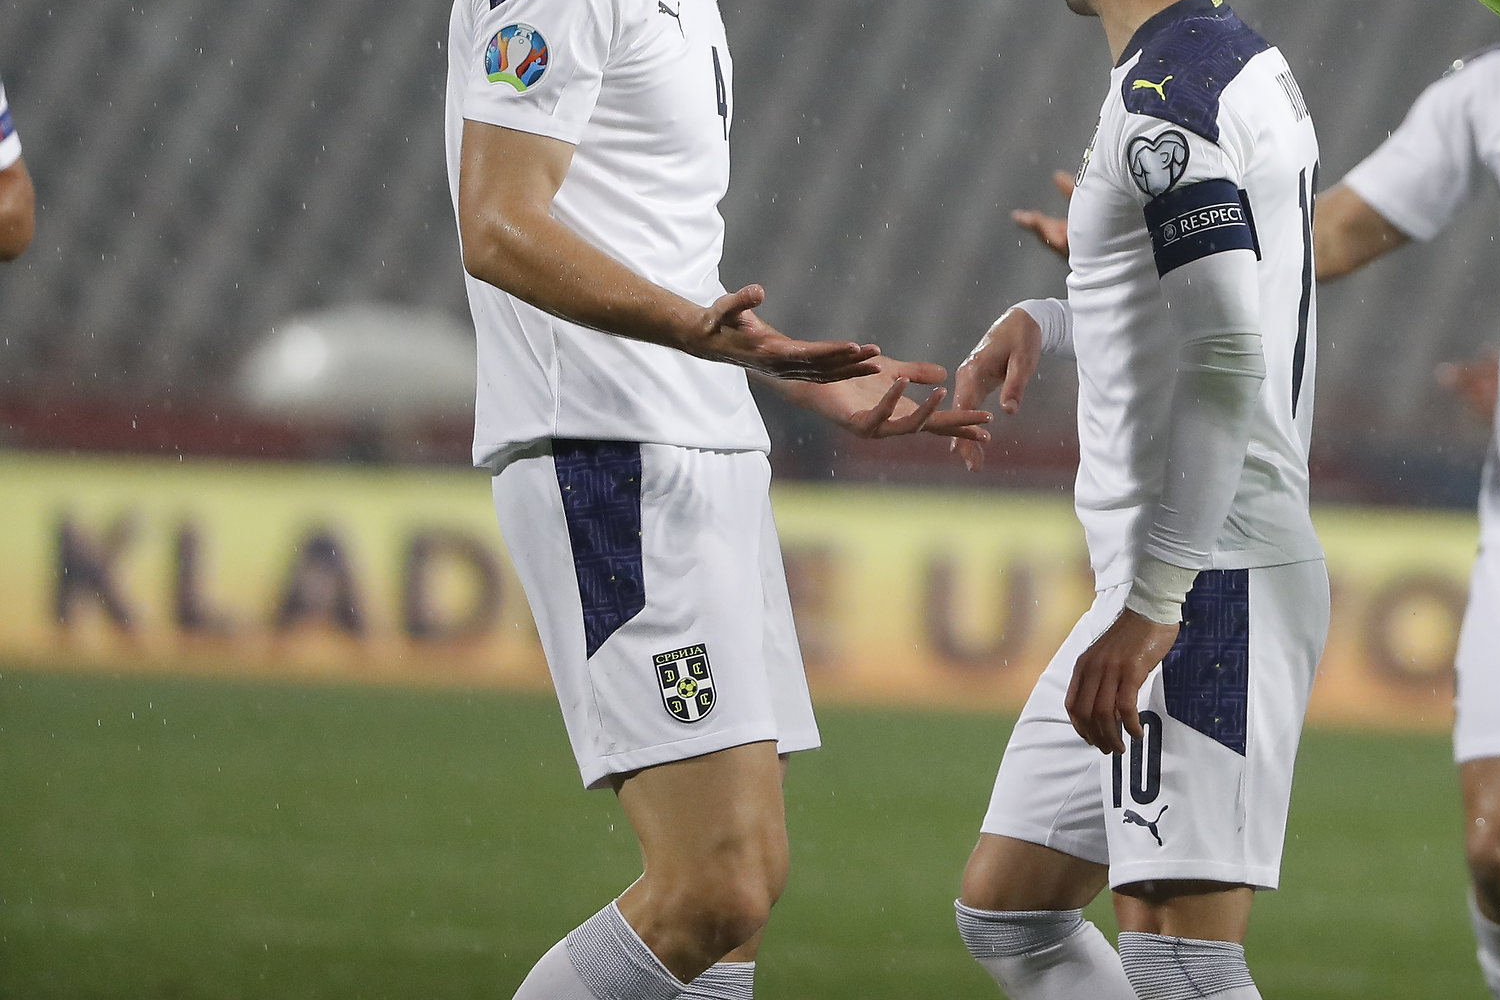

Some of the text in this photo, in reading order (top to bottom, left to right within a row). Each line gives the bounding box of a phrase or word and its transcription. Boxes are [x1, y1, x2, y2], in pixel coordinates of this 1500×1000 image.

[1180, 207, 1243, 233] RESPECT
[655, 646, 704, 664] СРБИЈА
[1112, 710, 1162, 809] 10
